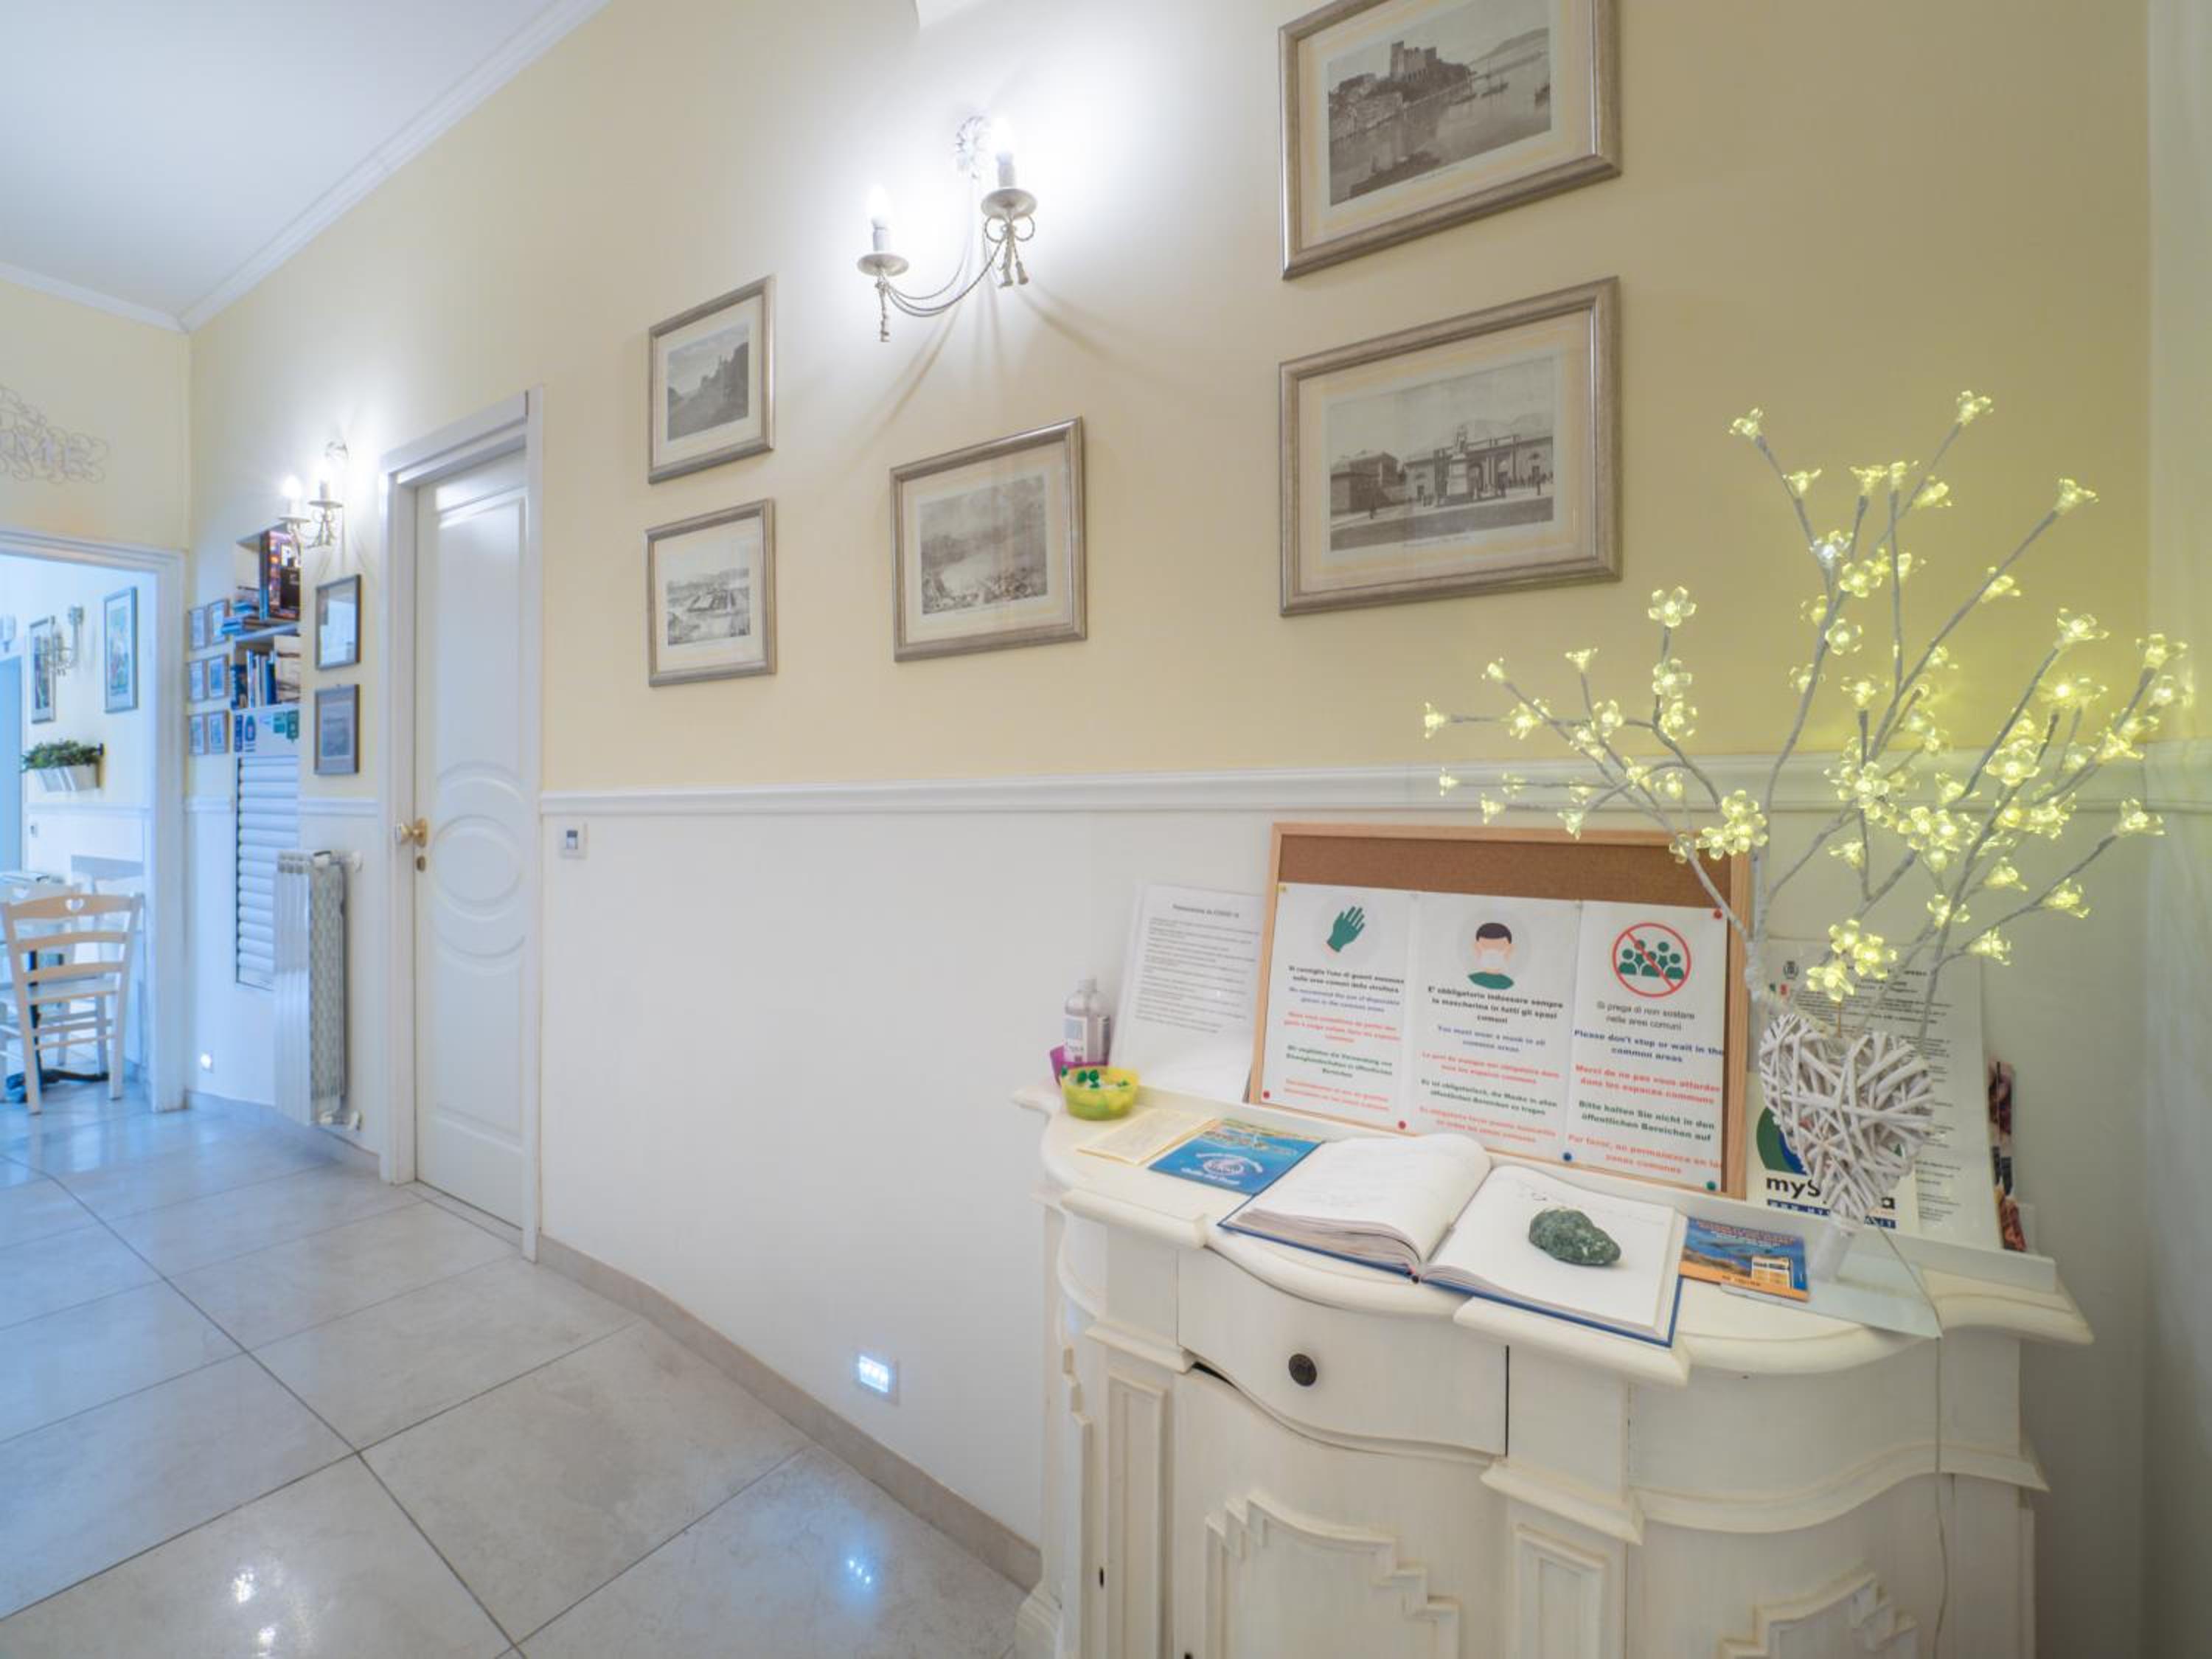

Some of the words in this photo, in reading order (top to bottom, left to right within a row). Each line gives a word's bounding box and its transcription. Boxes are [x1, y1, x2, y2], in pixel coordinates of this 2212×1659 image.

[1596, 1000, 1604, 1009] Si
[1607, 1004, 1631, 1015] prega
[1634, 1005, 1641, 1014] di
[1644, 1008, 1659, 1016] non
[1663, 1009, 1694, 1020] sostare
[1606, 1013, 1626, 1023] nelle
[1628, 1018, 1647, 1026] aree
[1649, 1019, 1681, 1031] comuni
[1574, 1029, 1604, 1040] Please
[1607, 1033, 1631, 1043] don't
[1634, 1036, 1655, 1048] stop
[1671, 1041, 1692, 1052] wait
[1696, 1045, 1705, 1054] in
[1611, 1047, 1652, 1058] common
[1655, 1053, 1683, 1062] areas
[1579, 1099, 1601, 1111] Bitte
[1604, 1104, 1634, 1116] halten
[1638, 1109, 1652, 1119] Sie
[1655, 1112, 1680, 1124] nicht
[1684, 1116, 1692, 1126] in
[1696, 1119, 1714, 1129] den
